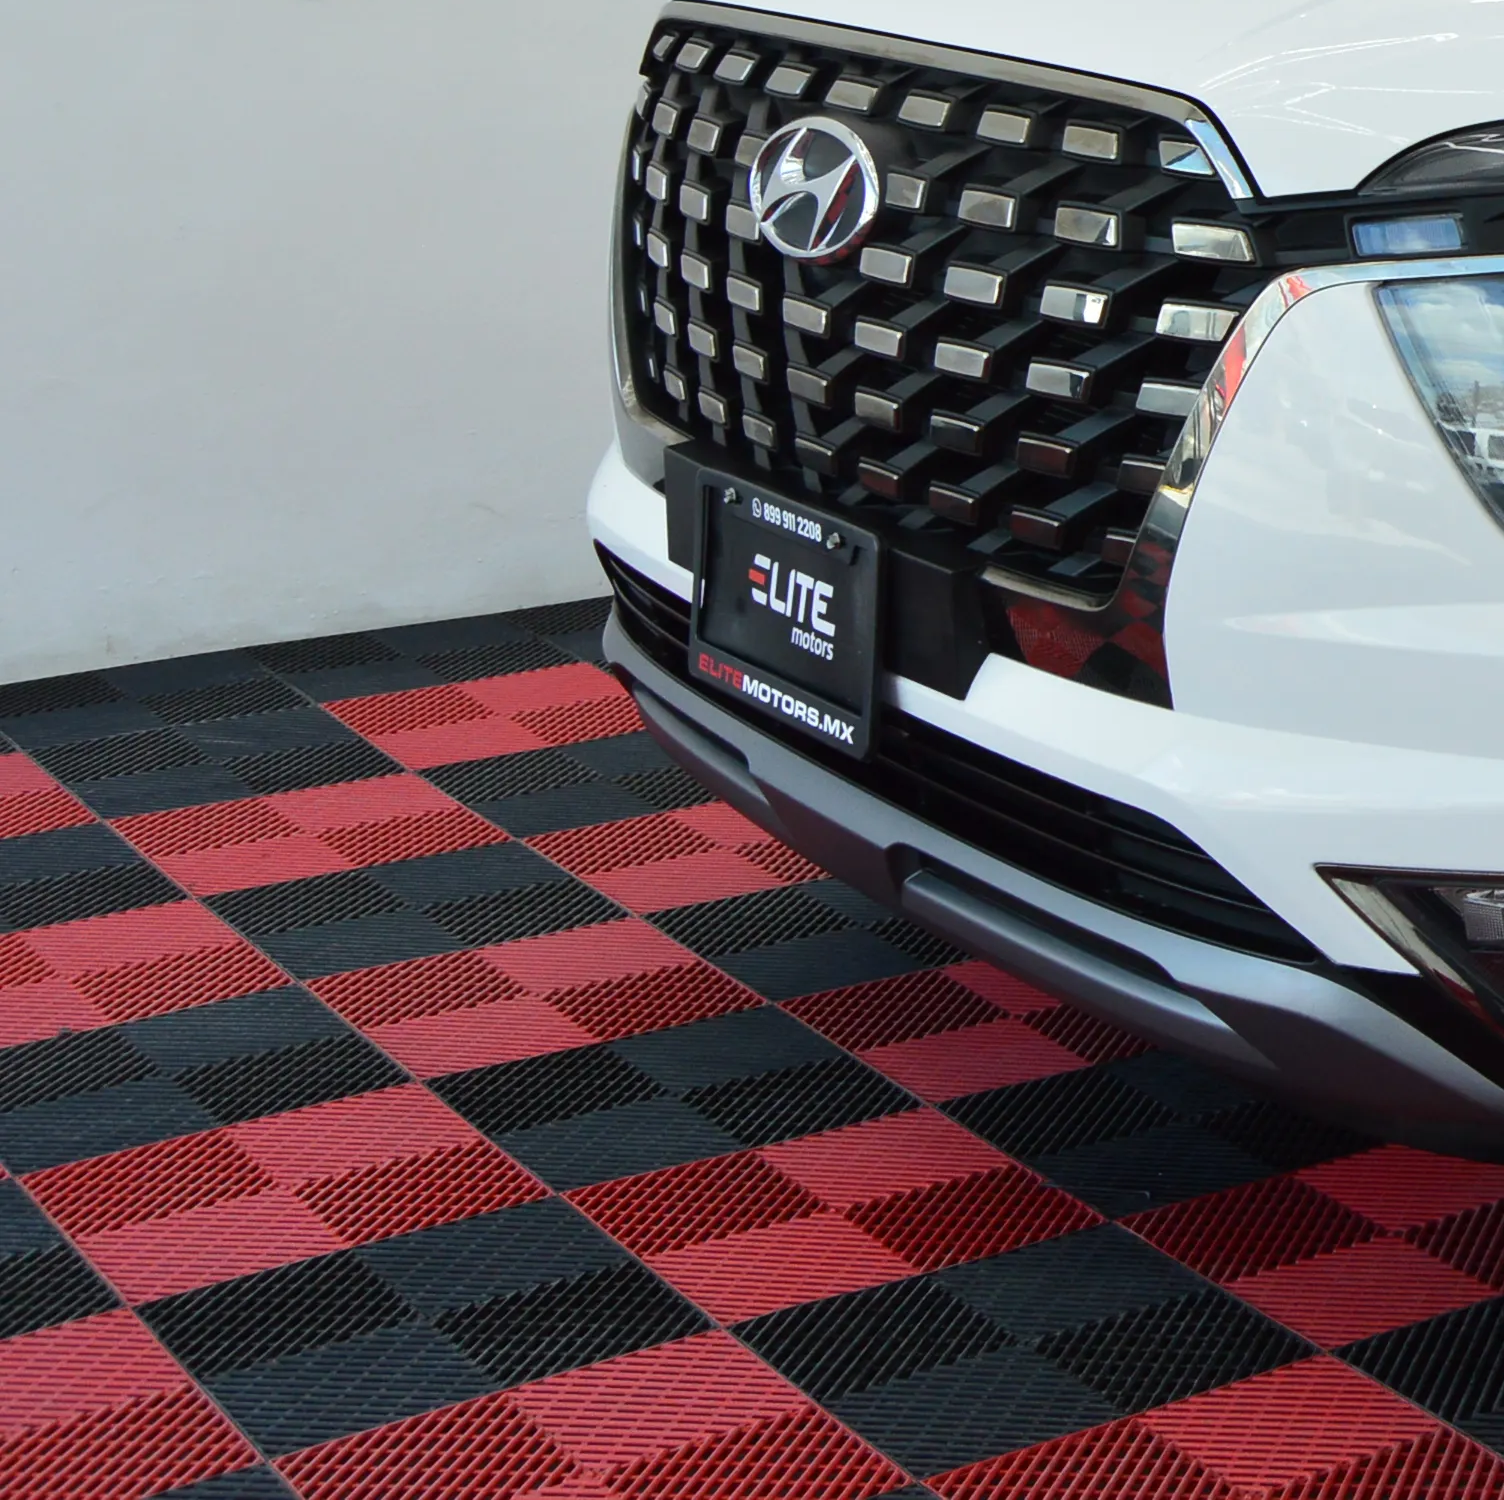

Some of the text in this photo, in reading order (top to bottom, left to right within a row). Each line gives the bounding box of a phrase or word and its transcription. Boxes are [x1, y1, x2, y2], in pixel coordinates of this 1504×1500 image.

[763, 502, 822, 543] 899 911 2208
[748, 553, 836, 638] ELITE
[790, 624, 834, 661] motors
[698, 651, 855, 746] ELITEMOTORS.MX
